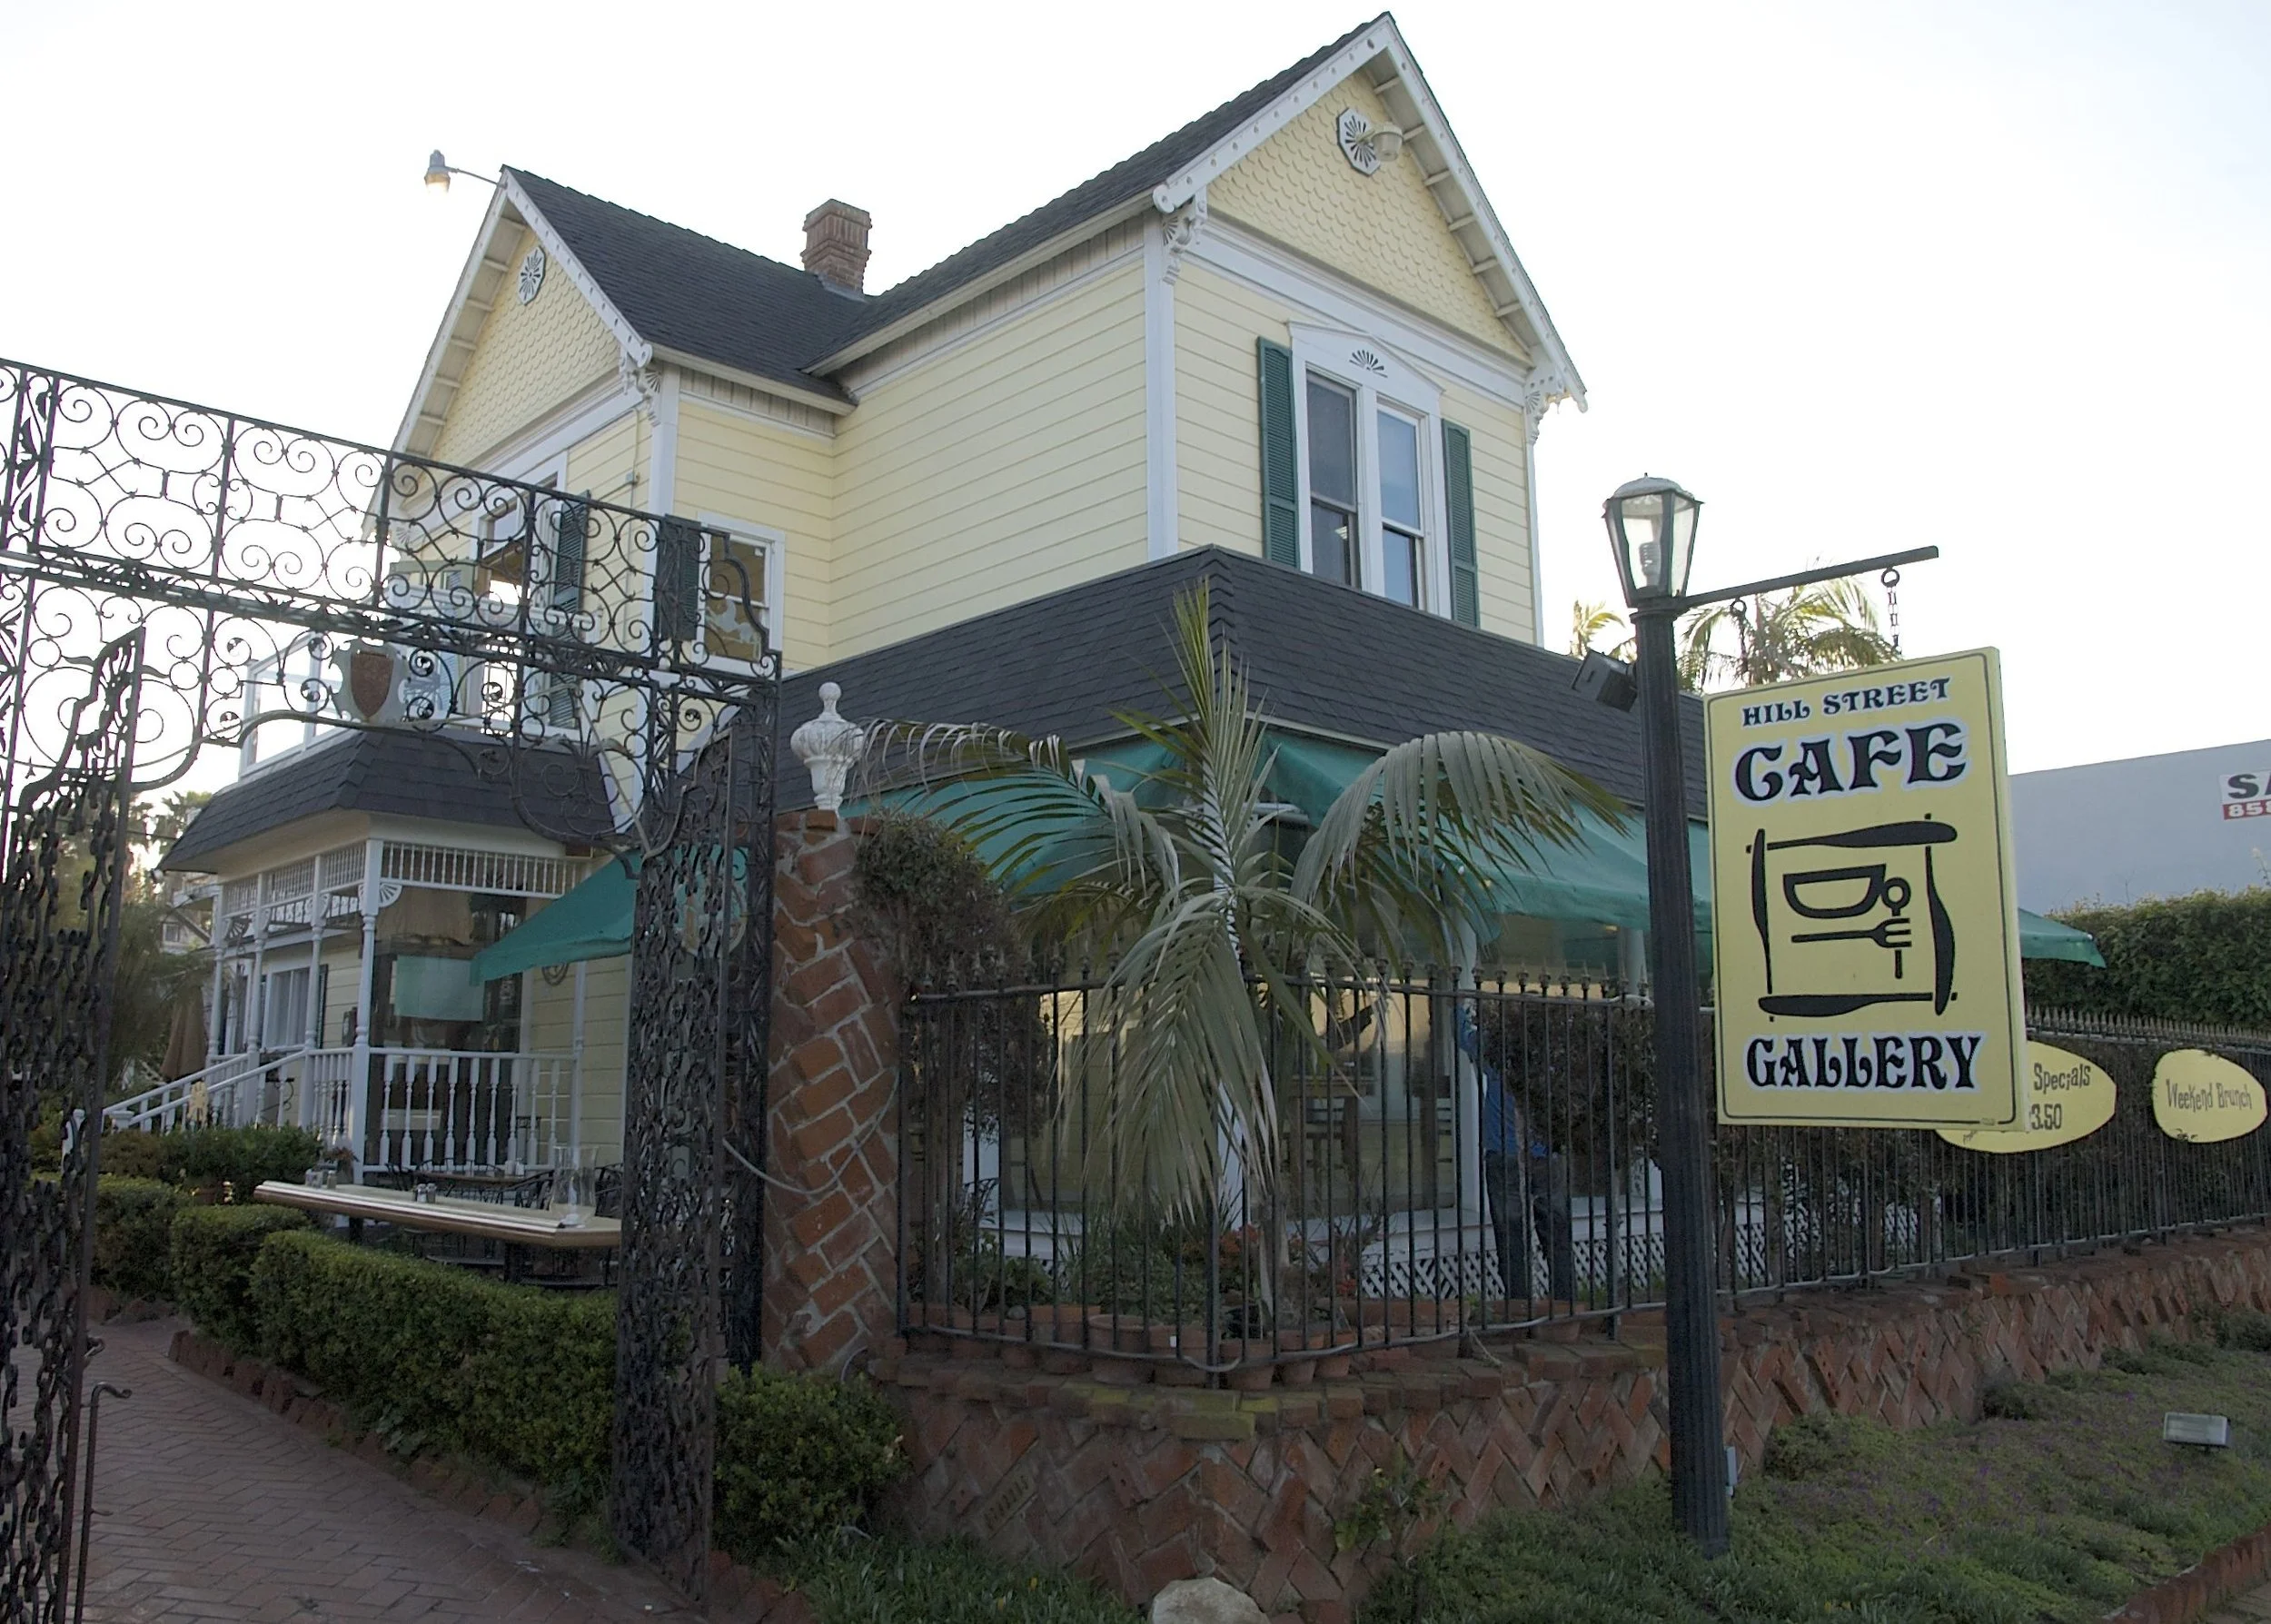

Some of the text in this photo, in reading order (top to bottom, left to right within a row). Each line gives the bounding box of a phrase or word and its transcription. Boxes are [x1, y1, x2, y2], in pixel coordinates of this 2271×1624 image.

[1742, 677, 1951, 727] HILL STREET
[1735, 723, 1967, 802] CAFE
[2227, 773, 2271, 799] S
[1747, 1035, 1982, 1090] GALLERY
[2033, 1062, 2091, 1094] Specials
[2216, 1082, 2253, 1110] Brunch
